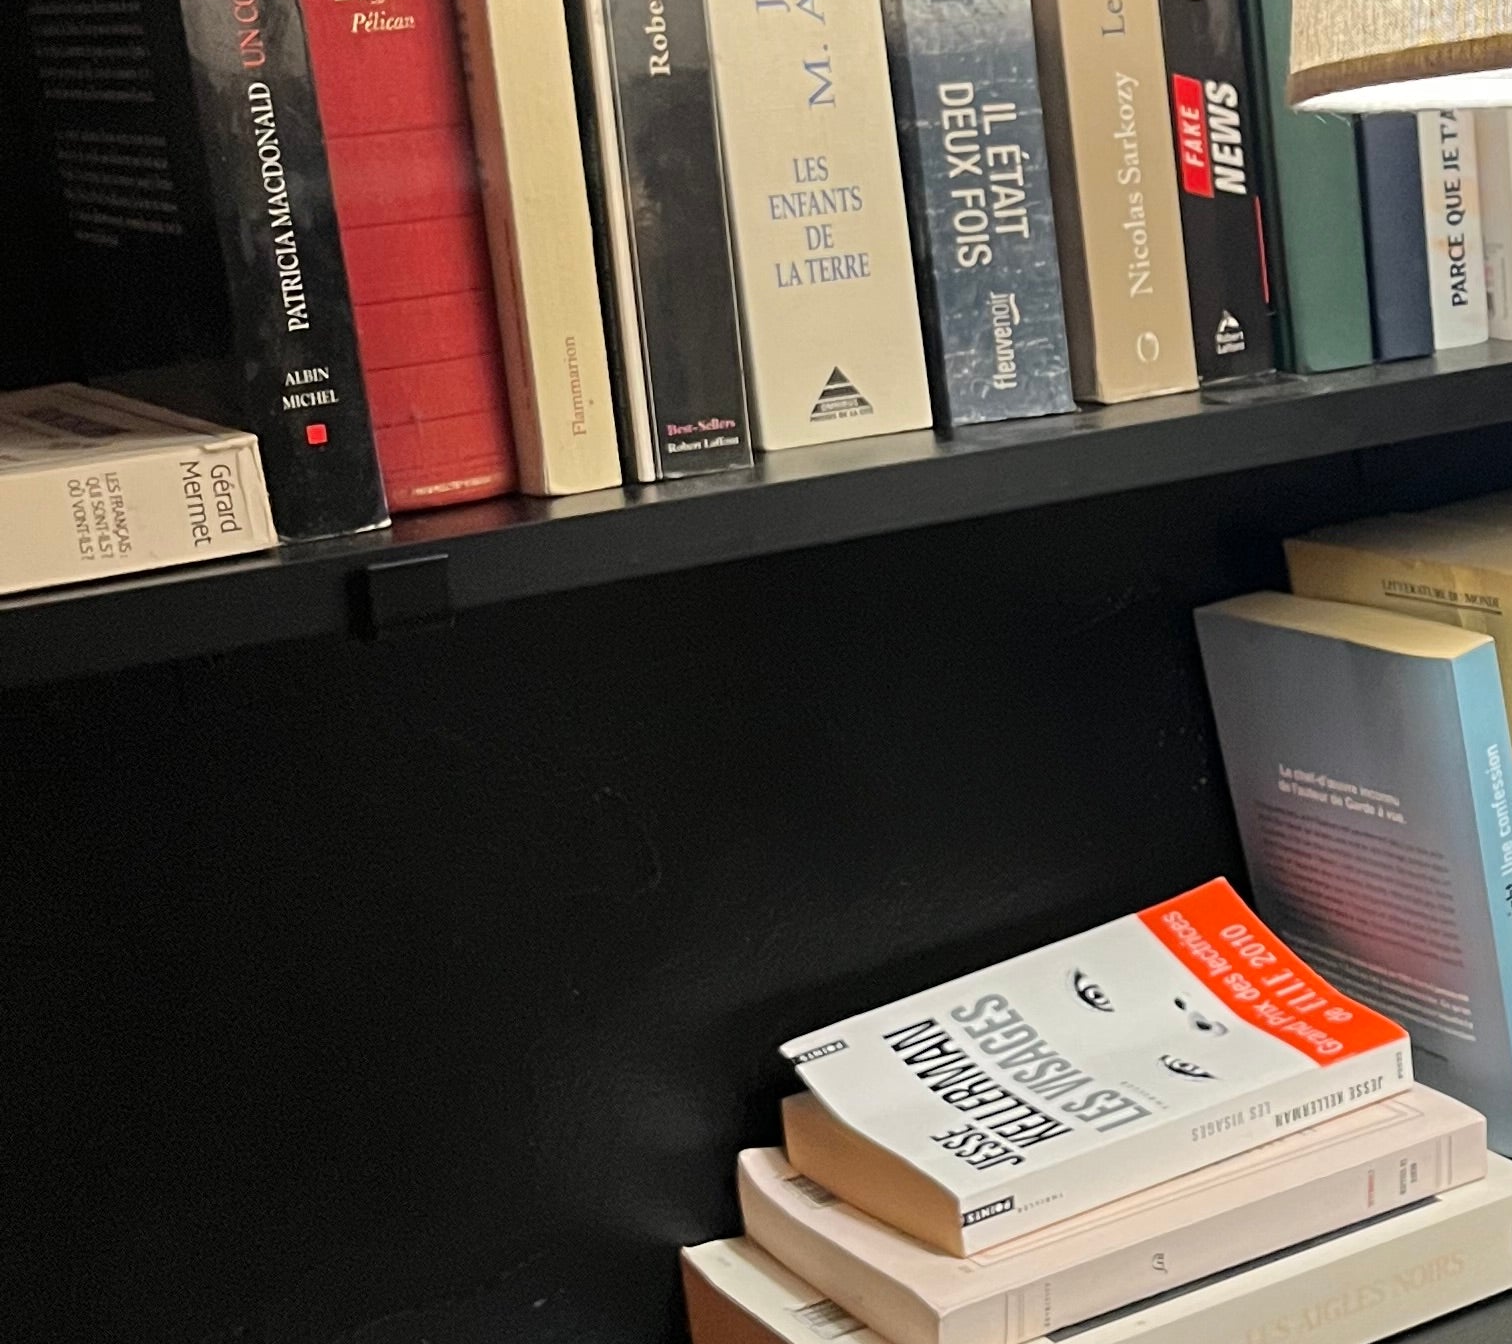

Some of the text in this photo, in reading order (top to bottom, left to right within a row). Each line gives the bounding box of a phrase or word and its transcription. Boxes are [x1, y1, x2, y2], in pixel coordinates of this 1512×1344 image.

[240, 28, 266, 69] UN
[351, 10, 416, 34] Pélican
[802, 44, 837, 109] M.
[1178, 104, 1205, 168] FAKE
[1204, 78, 1248, 195] NEWS
[792, 155, 830, 183] LES
[938, 81, 993, 268] DEUX FOIS
[982, 102, 1031, 239] IL ÉTAIT
[1114, 71, 1153, 299] Nicolas Sarkozy
[248, 81, 310, 332] PATRICIA MACDONALD
[768, 185, 863, 221] ENFANTS
[1441, 146, 1468, 307] PARCE QUE JE
[804, 223, 834, 251] DE
[775, 251, 871, 289] LA TERRE
[282, 389, 340, 411] MICHEL
[285, 366, 330, 387] ALBIN
[561, 335, 587, 437] Flammarion
[86, 476, 102, 499] QUI
[104, 470, 122, 493] LES
[180, 459, 212, 547] Mermet
[210, 463, 242, 534] Gérard
[1485, 742, 1512, 838] confession
[1218, 922, 1277, 969] 2010
[1162, 909, 1344, 1056] Grand Prix des lectrices
[1260, 968, 1329, 1015] ELLE
[1324, 1007, 1354, 1023] de
[882, 1016, 1075, 1149] KELLERMAN
[949, 992, 1153, 1134] LES VISAGES
[1191, 1100, 1272, 1143] LES VISAGES
[1274, 1075, 1384, 1129] JESSE KELLERMAN
[929, 1122, 1027, 1171] JESSE
[964, 1197, 1014, 1226] POINTS
[1302, 1277, 1388, 1332] AIGLES
[1391, 1251, 1465, 1294] NOIRS
